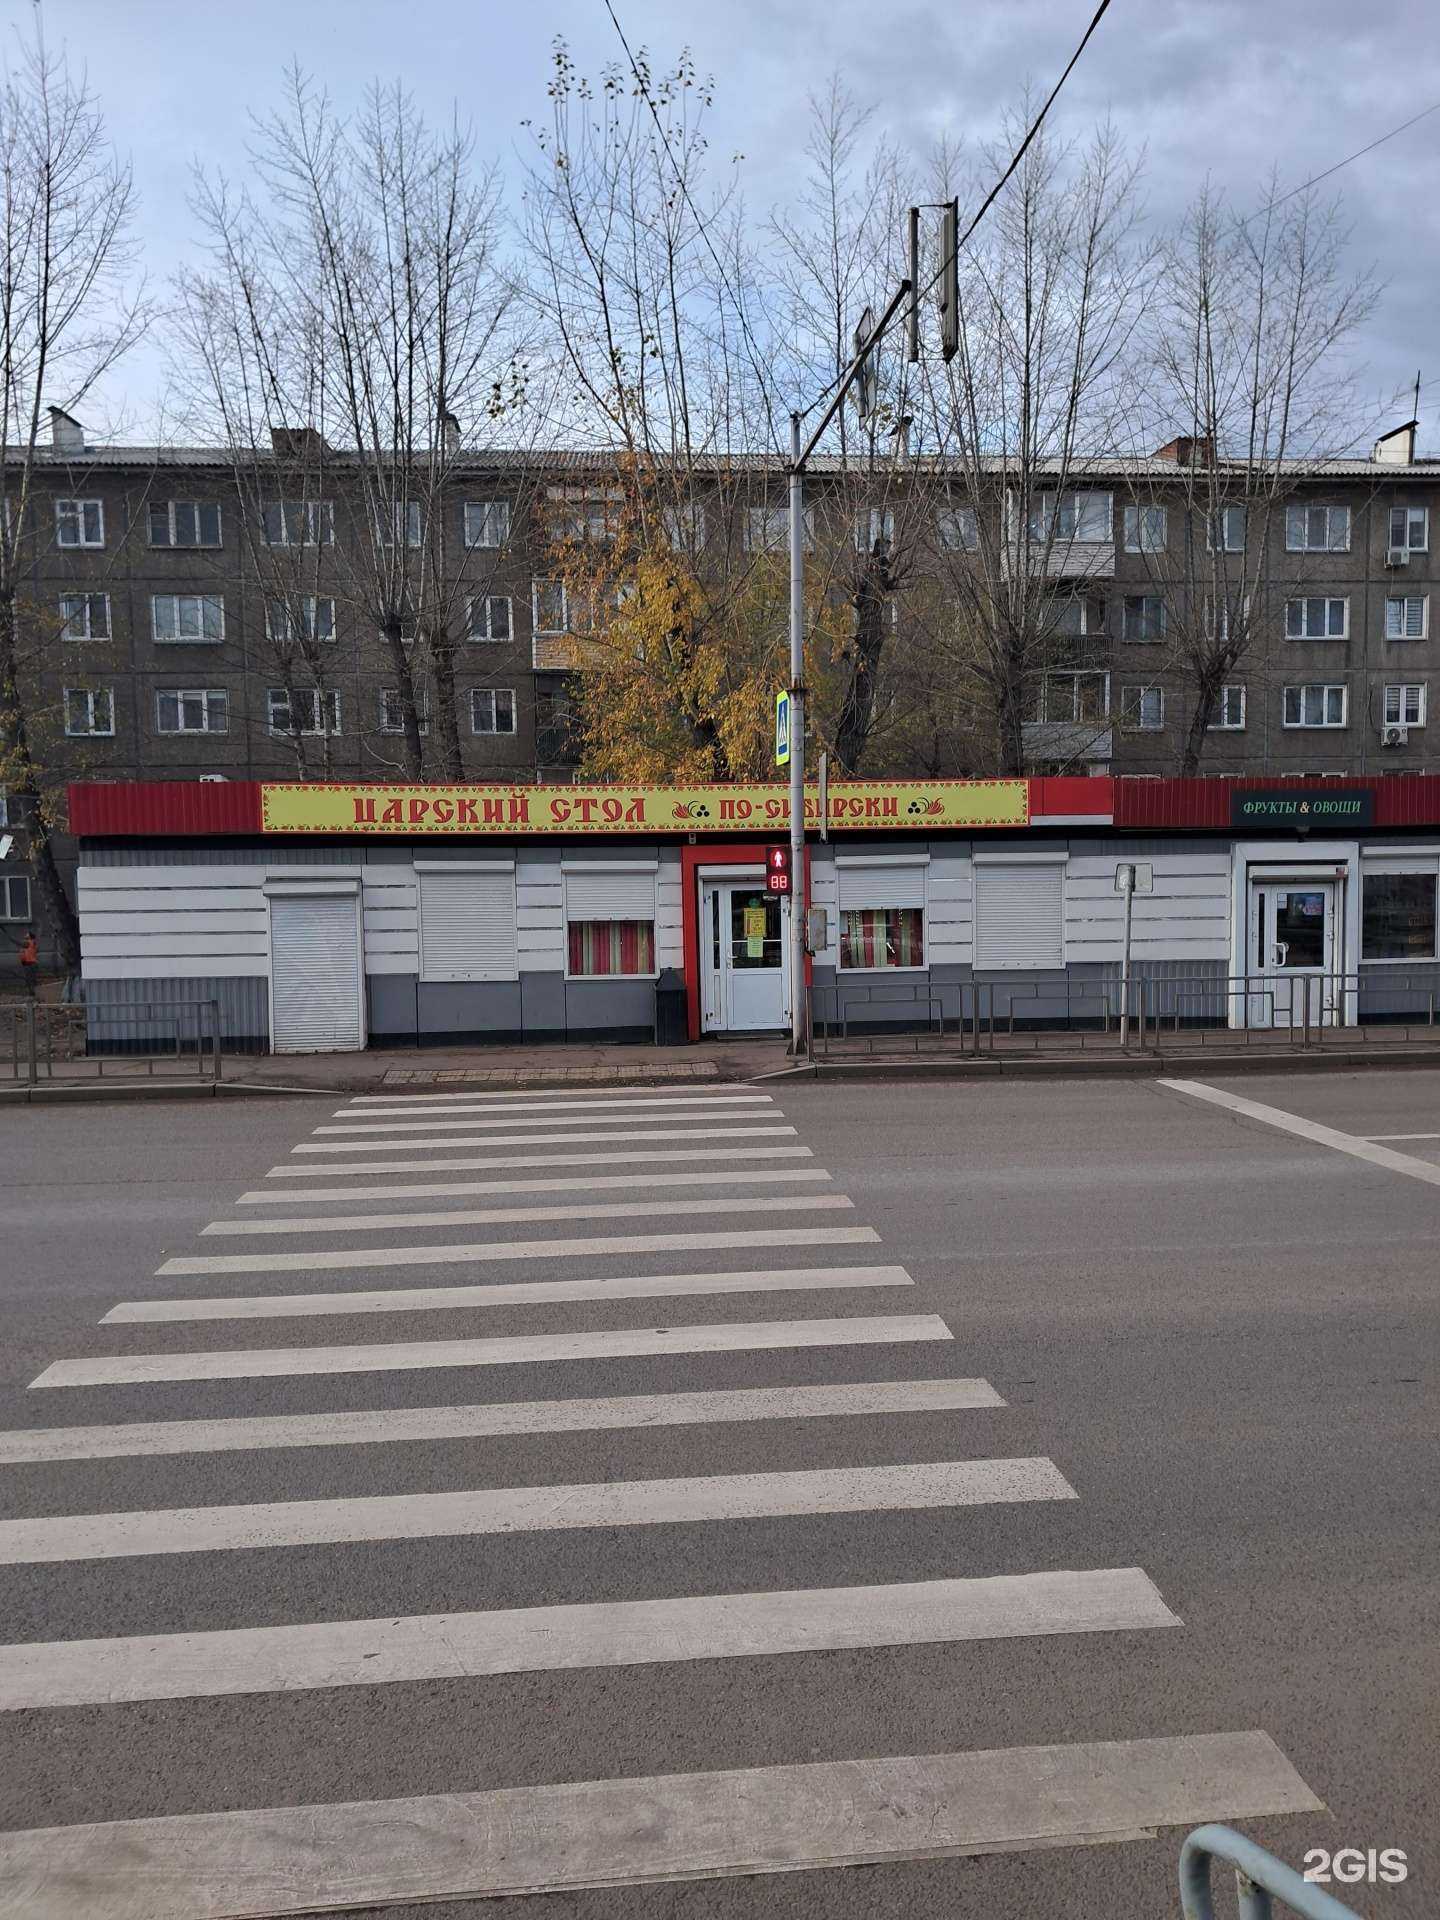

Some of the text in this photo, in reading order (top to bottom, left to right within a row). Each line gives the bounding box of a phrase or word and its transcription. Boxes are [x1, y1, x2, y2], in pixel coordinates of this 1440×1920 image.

[353, 793, 530, 824] ЦАРСКИЙ
[550, 798, 646, 823] СТОЛ
[1243, 800, 1361, 814] ФРУКТЫ & ОВОЩИ
[771, 875, 787, 889] 88
